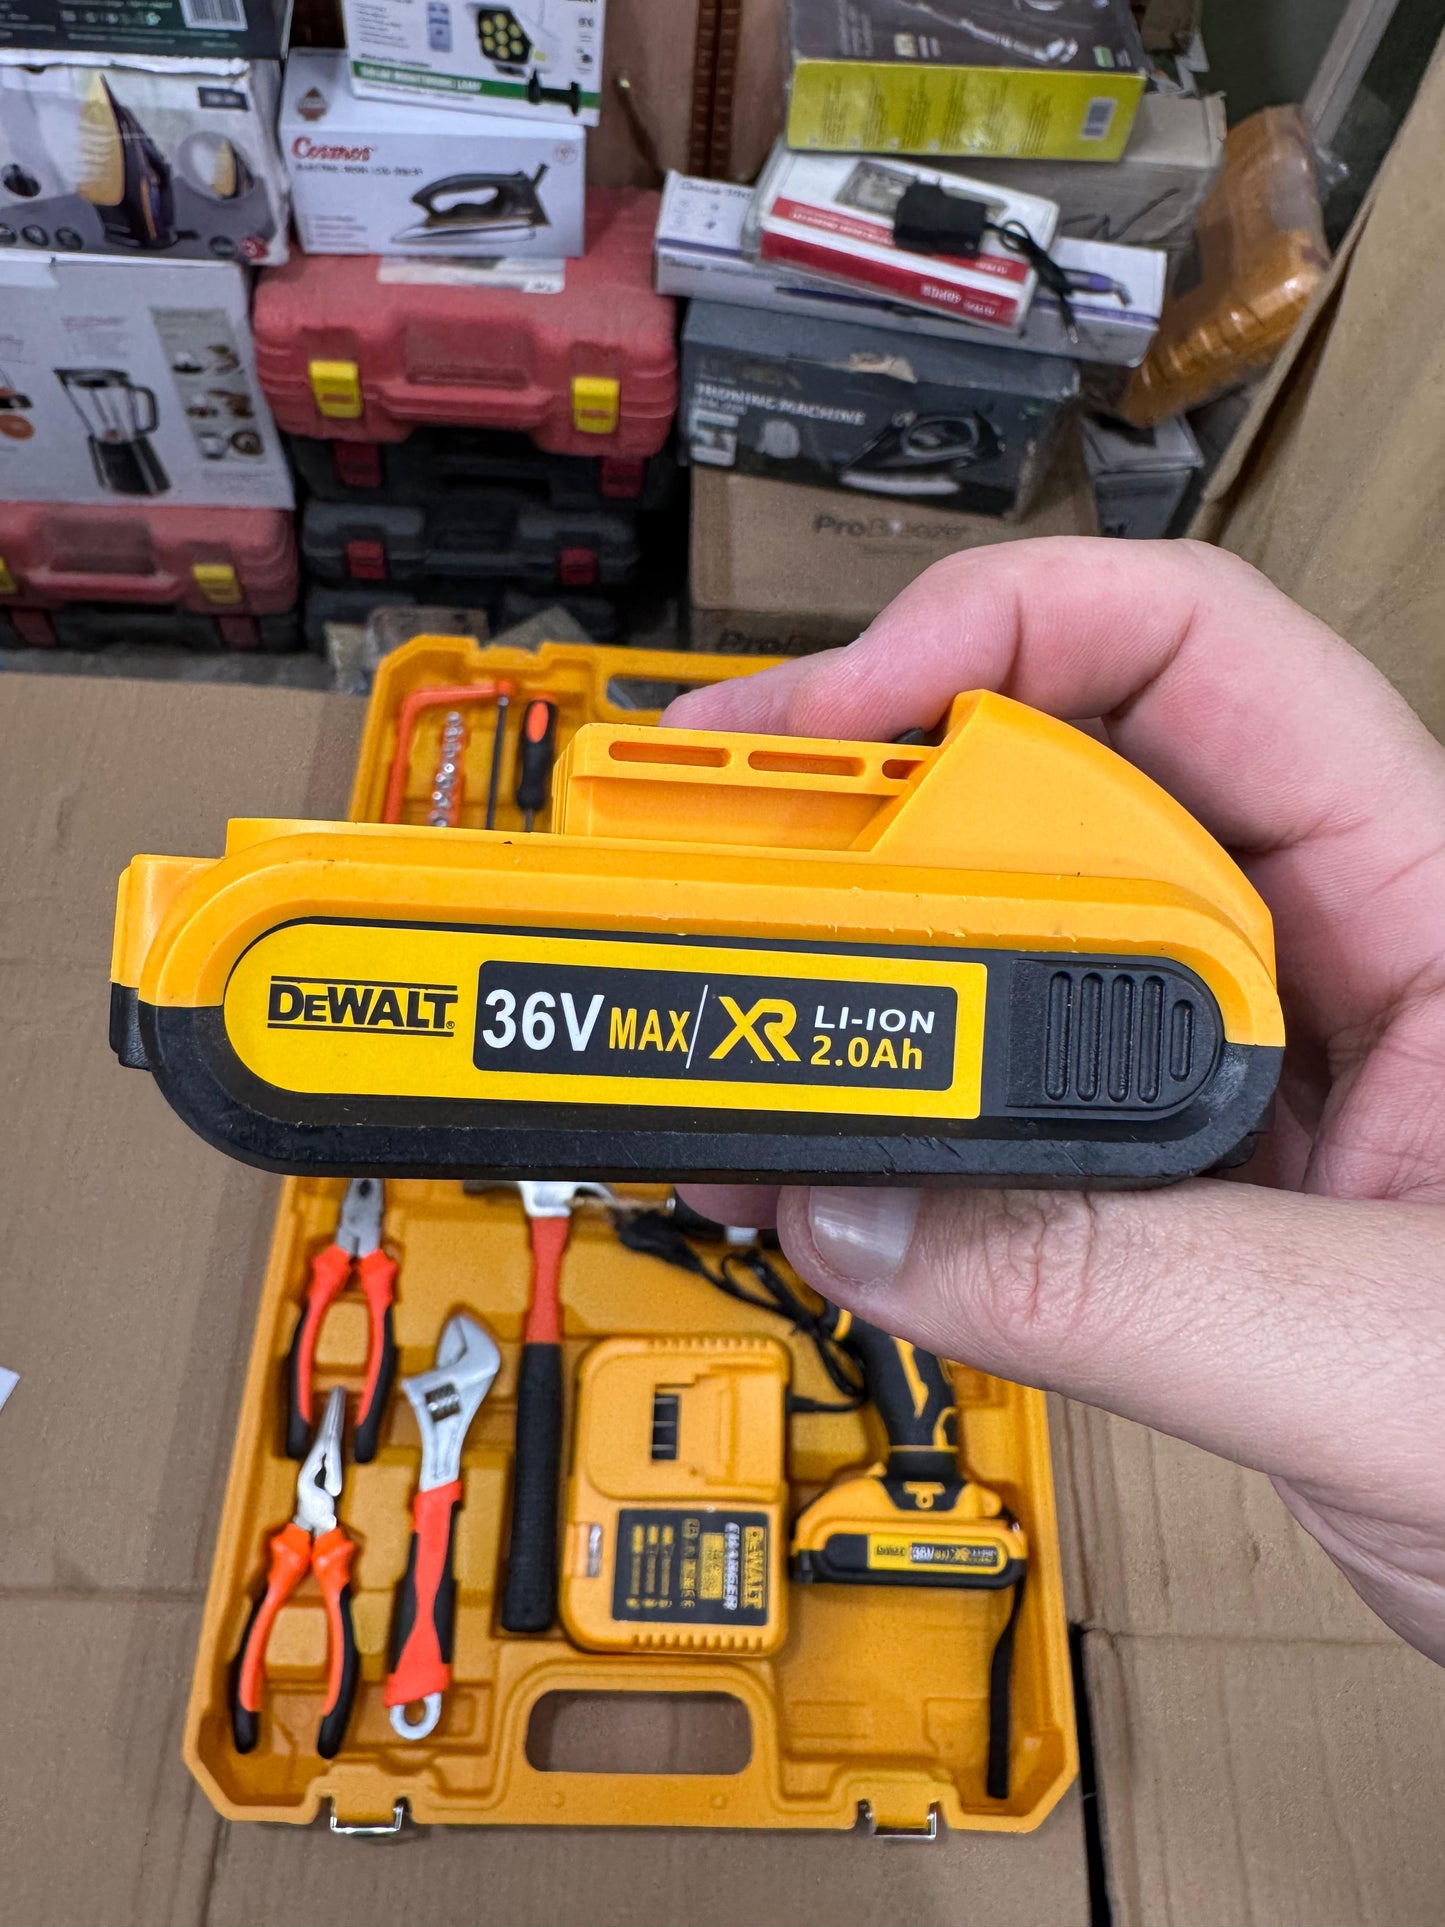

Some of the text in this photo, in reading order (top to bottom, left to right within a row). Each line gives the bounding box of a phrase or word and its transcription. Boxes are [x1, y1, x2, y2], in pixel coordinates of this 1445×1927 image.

[291, 136, 371, 162] Cosmos
[267, 983, 458, 1030] DEWALT
[482, 988, 801, 1063] 36V MAX XR
[814, 1005, 936, 1034] LI-ION
[810, 1034, 923, 1070] 2.0Ah
[722, 1521, 741, 1611] CHARGER
